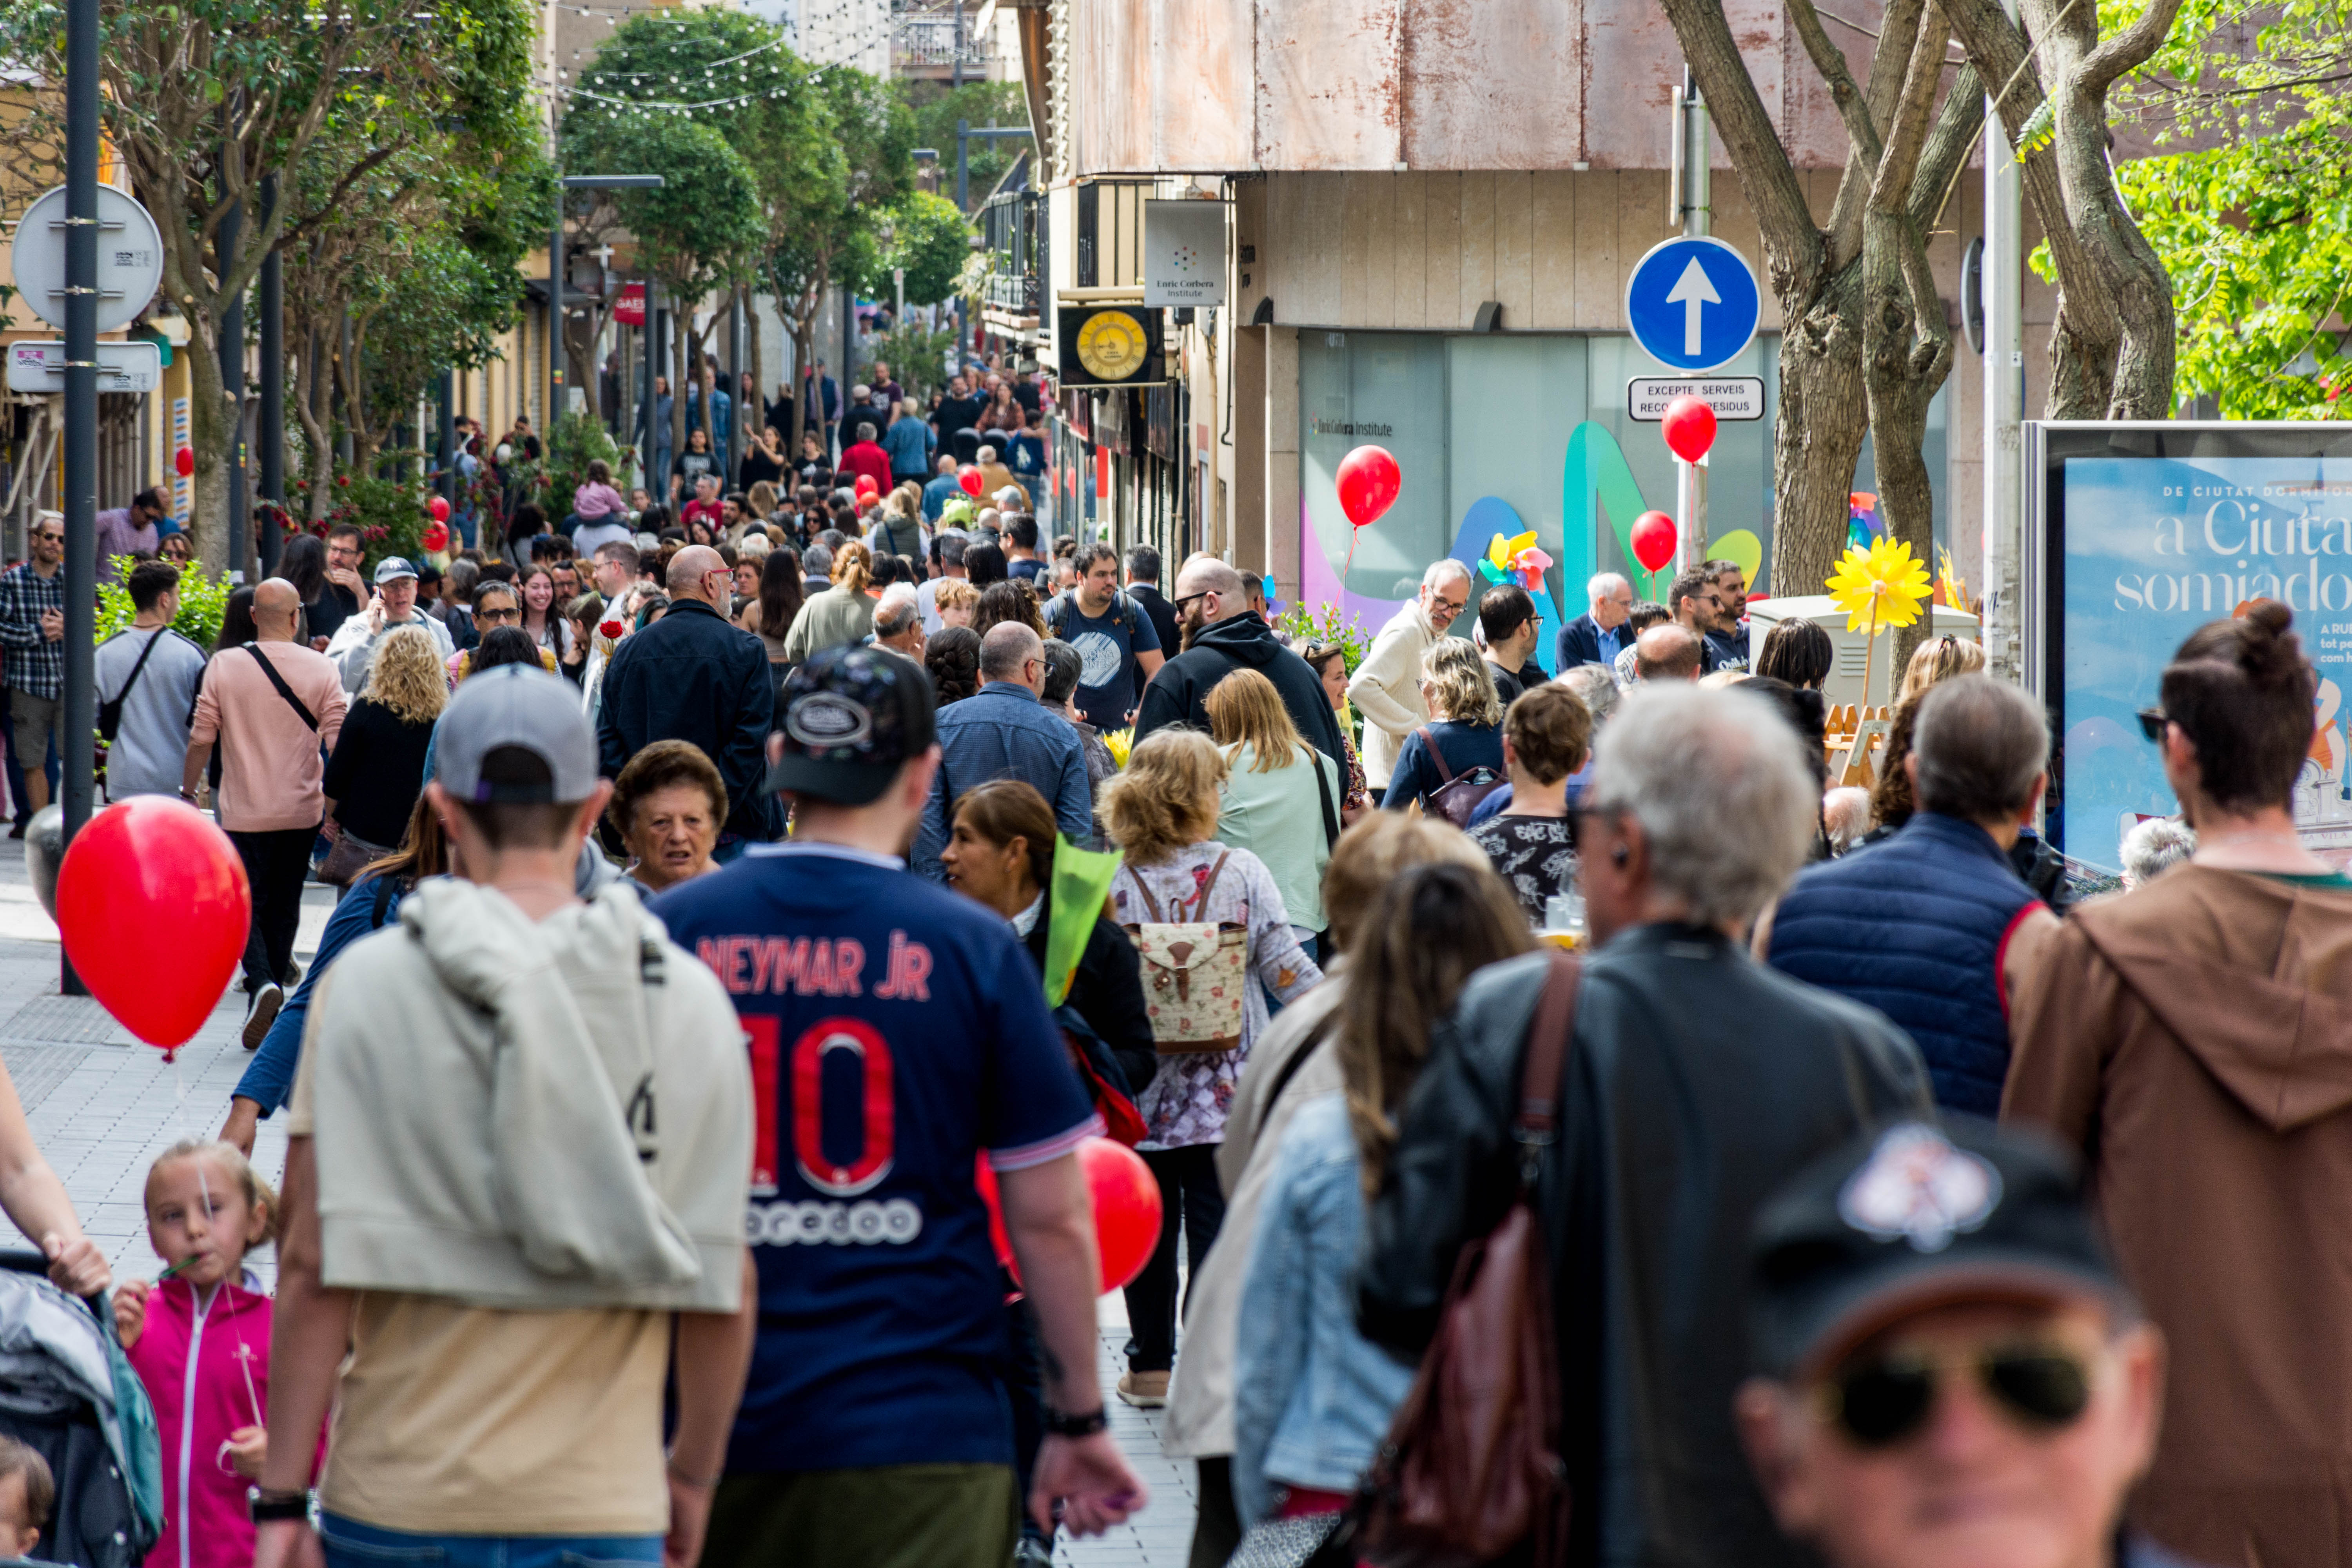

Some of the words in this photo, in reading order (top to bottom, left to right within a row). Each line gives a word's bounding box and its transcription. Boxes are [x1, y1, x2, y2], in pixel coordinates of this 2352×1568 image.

[1648, 386, 1694, 396] EXCEPTE
[1702, 385, 1744, 395] SERVEIS
[1641, 403, 1671, 412] RECO
[1356, 421, 1392, 437] Institute
[2163, 487, 2183, 497] DE
[2194, 487, 2254, 497] CIUTAT
[2154, 516, 2188, 555] a
[2204, 499, 2352, 555] Ciuta
[2114, 555, 2352, 612] somiado
[2321, 624, 2329, 634] A
[2321, 638, 2337, 648] tot
[696, 935, 865, 996] NEYMAR
[737, 1012, 895, 1197] 10
